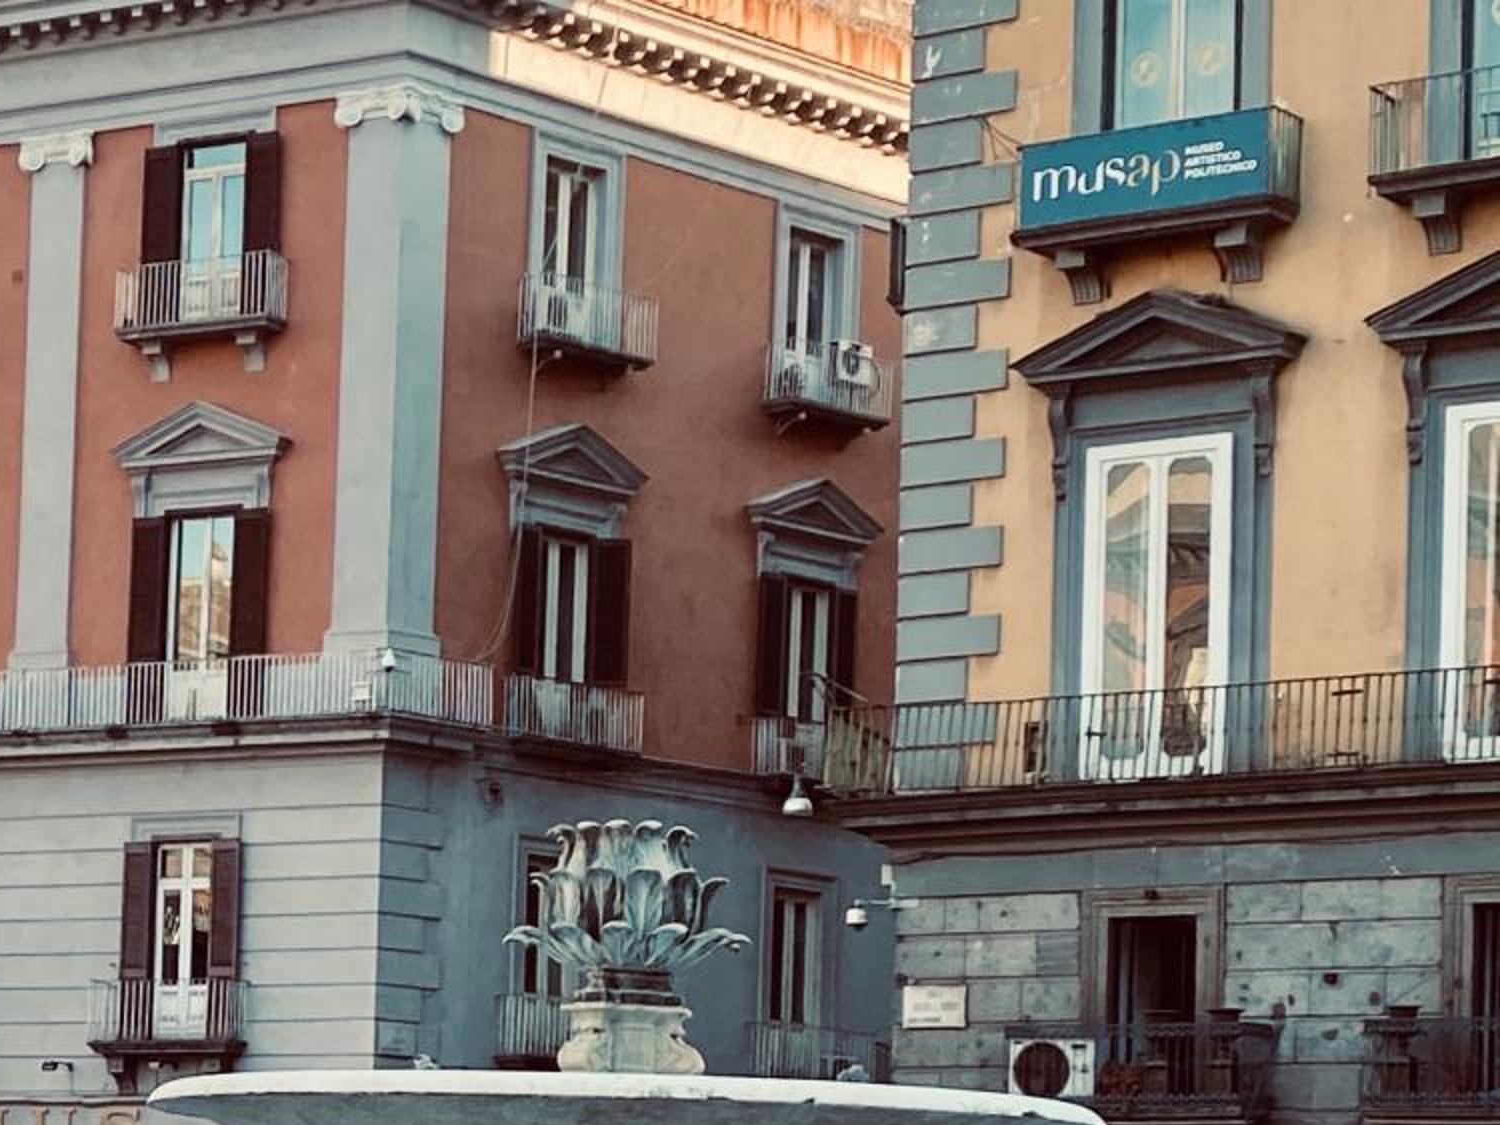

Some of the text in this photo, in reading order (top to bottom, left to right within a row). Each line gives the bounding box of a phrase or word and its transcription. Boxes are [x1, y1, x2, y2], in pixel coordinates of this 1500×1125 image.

[1184, 141, 1225, 155] MUSEO
[1184, 150, 1242, 168] ARTISTICO
[1032, 149, 1181, 203] musap
[1184, 159, 1258, 180] POLITECNICO
